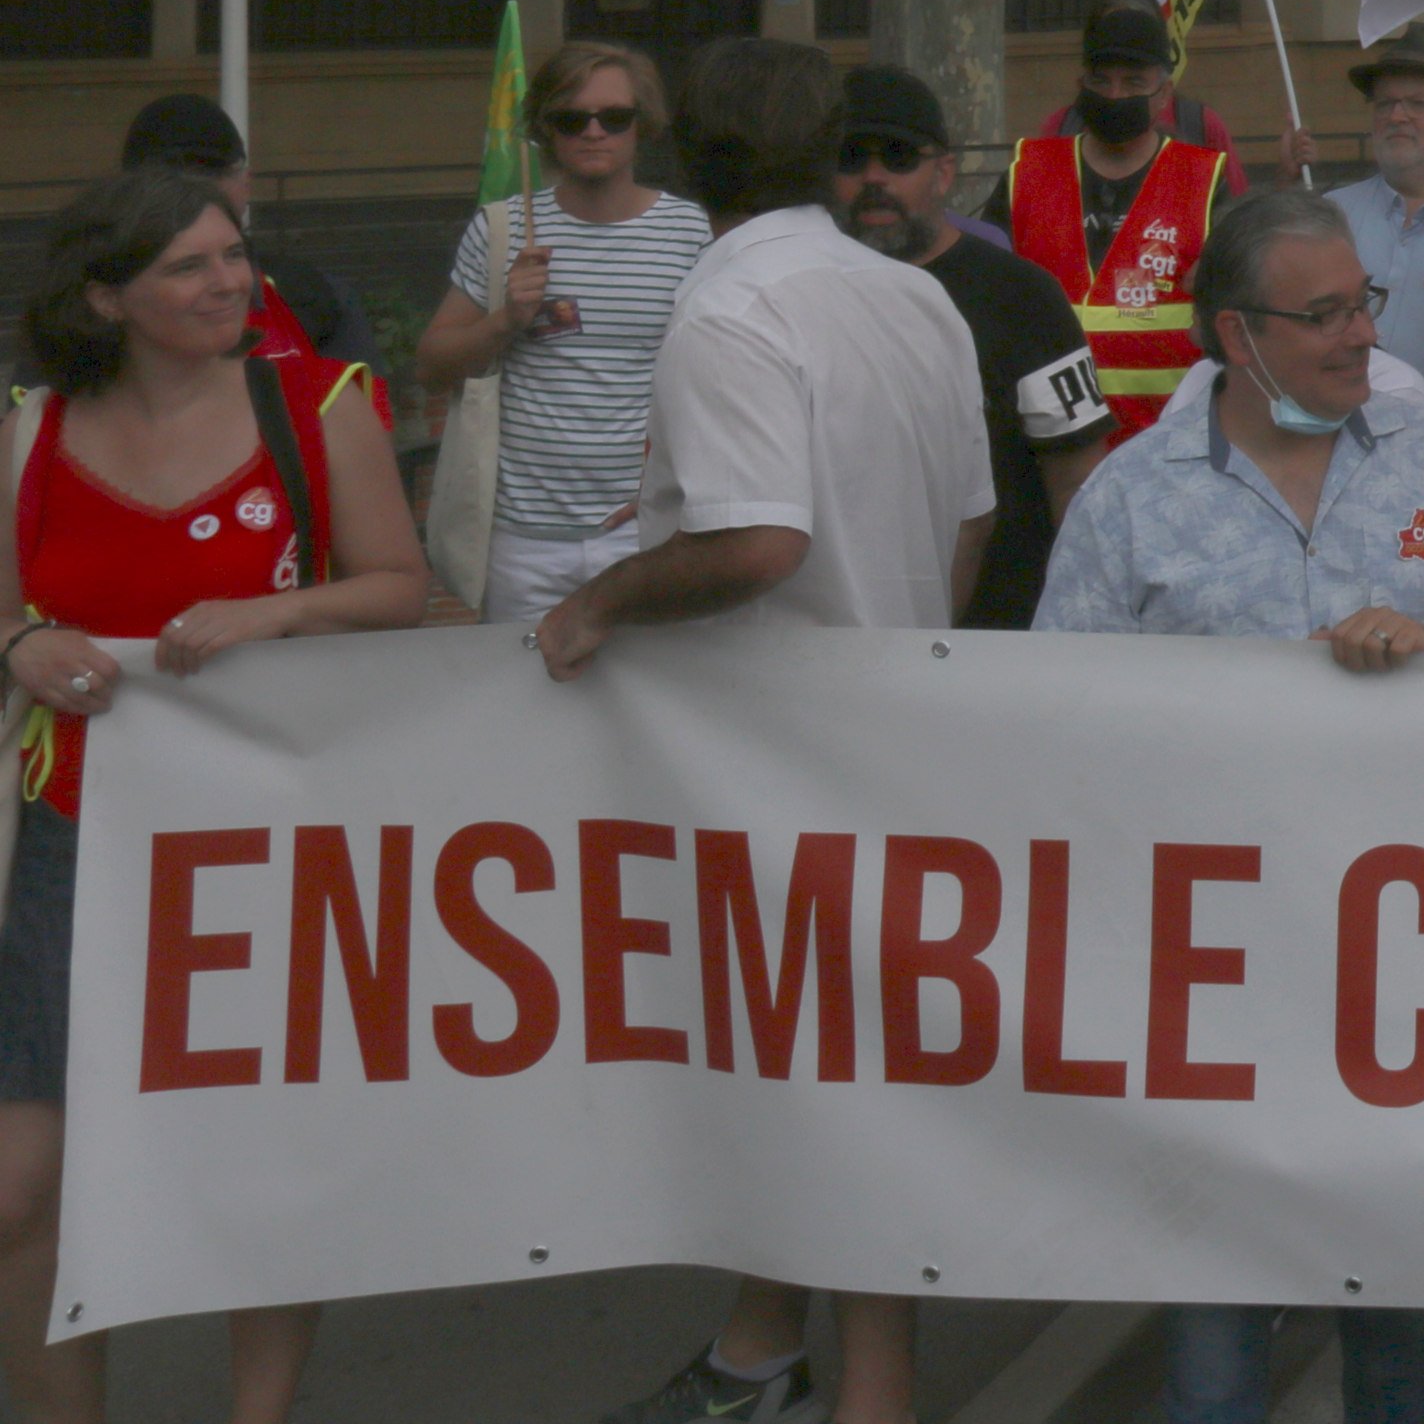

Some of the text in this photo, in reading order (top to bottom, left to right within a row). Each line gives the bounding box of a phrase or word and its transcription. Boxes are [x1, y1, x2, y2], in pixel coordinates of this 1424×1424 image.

[1139, 253, 1177, 277] cgt
[1116, 282, 1157, 308] cgt
[237, 502, 276, 526] cg
[141, 820, 1259, 1099] ENSEMBLE
